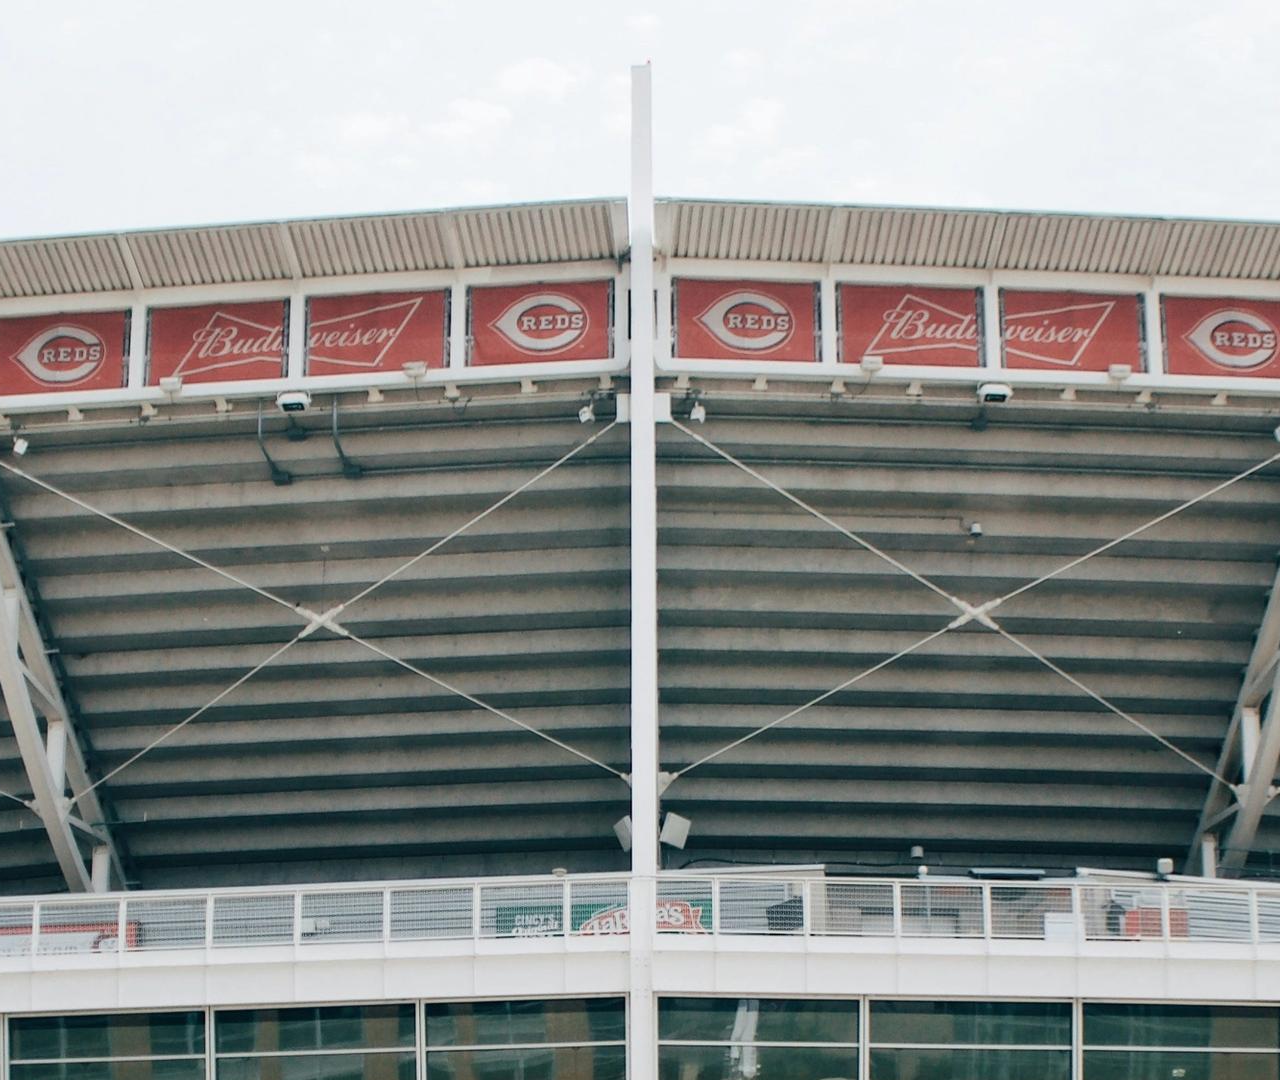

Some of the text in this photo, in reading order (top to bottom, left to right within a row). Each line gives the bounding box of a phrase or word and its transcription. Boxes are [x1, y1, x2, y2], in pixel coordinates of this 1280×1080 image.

[521, 312, 584, 331] REDS
[727, 313, 789, 332] REDS
[1211, 329, 1276, 349] REDS
[40, 344, 102, 363] REDS
